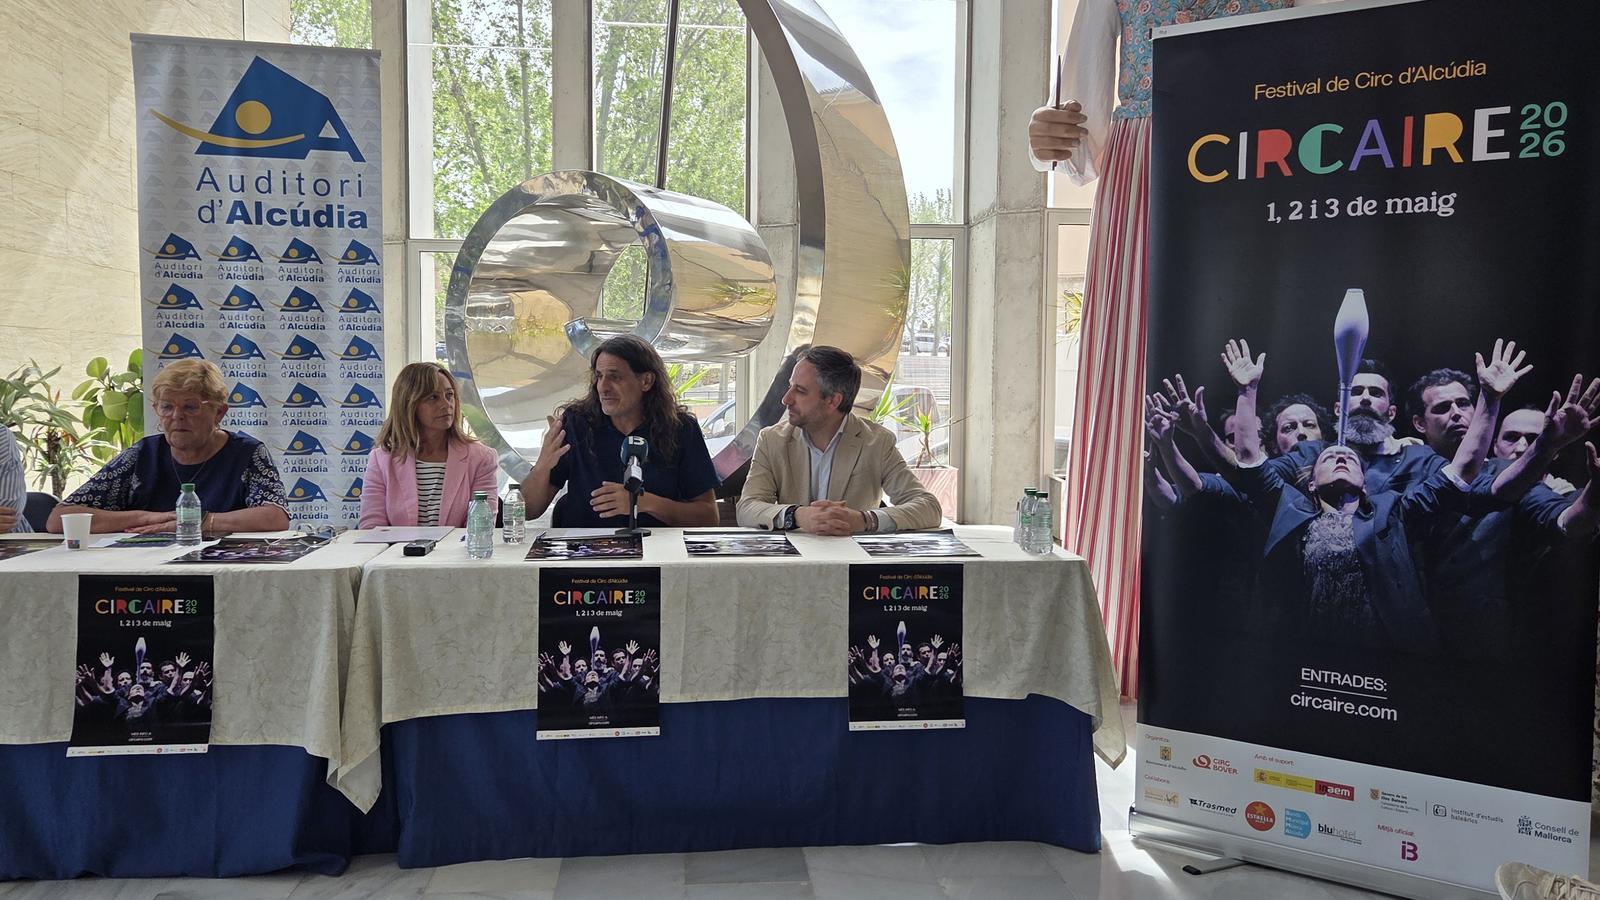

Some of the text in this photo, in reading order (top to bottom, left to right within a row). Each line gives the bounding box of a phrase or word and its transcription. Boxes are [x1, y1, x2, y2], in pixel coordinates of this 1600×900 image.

[1254, 60, 1487, 100] Festival de Circ d'Alcúdia
[1519, 101, 1568, 130] 20
[1187, 105, 1511, 183] CIRCAIRE
[1518, 130, 1566, 159] 26
[195, 166, 363, 198] Auditori
[1266, 191, 1458, 223] 1, 2 i 3 de maig
[197, 199, 368, 229] d'Alcúdia
[154, 262, 202, 271] Auditori
[217, 264, 264, 273] Auditori
[278, 265, 323, 274] Auditori
[154, 270, 203, 279] d'Alcúdia
[337, 267, 380, 276] Auditori
[217, 272, 264, 281] d'Alcúdia
[278, 274, 325, 283] d'Alcúdia
[337, 275, 381, 284] d'Alcúdia
[156, 312, 203, 320] Auditori
[219, 313, 265, 321] Auditori
[279, 314, 325, 322] Auditori
[338, 315, 381, 324] Auditori
[156, 320, 205, 329] d'Alcúdia
[219, 321, 266, 330] d'Alcúdia
[279, 322, 326, 331] d'Alcúdia
[338, 323, 382, 332] d'Alcúdia
[220, 361, 266, 370] Auditori
[280, 362, 326, 370] Auditori
[339, 363, 382, 371] Auditori
[280, 370, 327, 379] d'Alcúdia
[339, 370, 383, 379] d'Alcúdia
[281, 410, 326, 418] Auditori
[340, 410, 383, 418] Auditori
[282, 418, 328, 426] d'Alcúdia
[283, 457, 327, 465] Auditori
[283, 465, 328, 473] d'Alcúdia
[290, 504, 328, 512] uditori
[862, 585, 938, 600] CIRCAIRE
[938, 585, 949, 593] 20
[553, 590, 634, 605] CIRCAIRE
[95, 599, 185, 614] CIRCAIRE
[185, 599, 198, 607] 20
[605, 609, 623, 617] maig
[125, 619, 131, 627] 2
[135, 619, 141, 627] 3
[142, 619, 152, 627] de
[152, 619, 172, 628] maig
[1301, 667, 1387, 692] ENTRADES:
[1290, 691, 1398, 721] circaire.com
[1212, 765, 1239, 775] BOVER
[1198, 800, 1237, 814] Trasmed
[1246, 813, 1274, 823] ESTRELLA
[1534, 821, 1580, 837] Consell de
[1534, 830, 1573, 844] Mallorca
